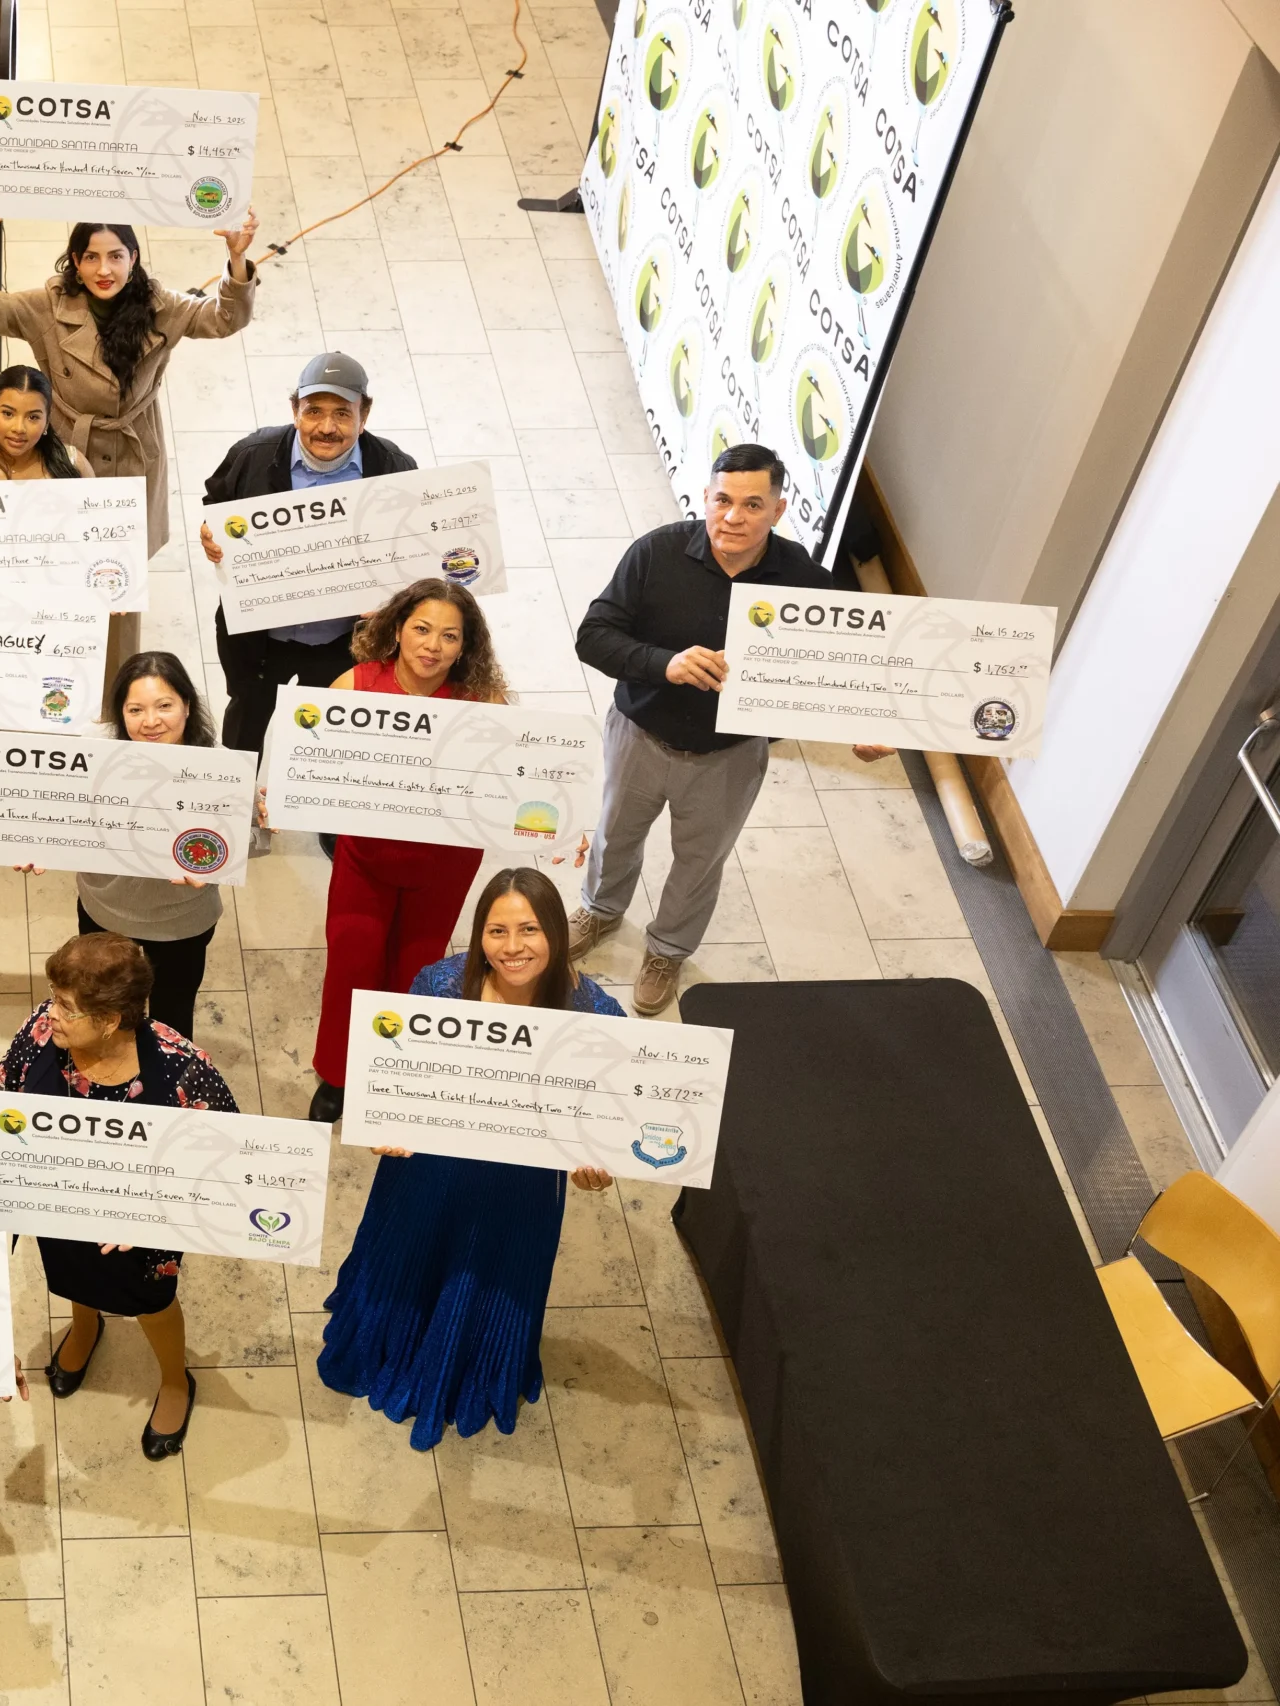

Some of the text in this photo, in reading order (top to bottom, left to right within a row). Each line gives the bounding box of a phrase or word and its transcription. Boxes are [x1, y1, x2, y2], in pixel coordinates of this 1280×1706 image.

[827, 20, 869, 107] COTSA
[16, 96, 111, 120] COTSA
[61, 139, 96, 151] SANTA
[98, 141, 138, 153] MARTA
[747, 113, 782, 194] COTSA
[875, 108, 916, 203] COTSA
[661, 187, 693, 264] COTSA
[781, 197, 810, 284] COTSA
[694, 268, 723, 350] COTSA
[809, 289, 869, 382] COTSA
[720, 355, 760, 442] COTSA
[251, 498, 346, 530] COTSA
[233, 545, 301, 564] COMUNIDAD
[303, 539, 333, 553] JUAN
[780, 603, 886, 631] COTSA
[747, 645, 913, 668] COMUNIDAD SANTA CLARA
[325, 705, 432, 734] COTSA
[738, 696, 898, 719] FONDO DE BECAS Y PROYECTOS
[521, 731, 586, 749] Nov 15 2025
[293, 745, 432, 767] COMUNIDAD CENTENO
[180, 767, 241, 783] Nov 15 2025
[32, 789, 75, 801] TIERRA
[78, 793, 129, 806] BLANCA
[409, 1013, 532, 1048] COTSA
[373, 1056, 596, 1091] COMUNIDAD TROMPINA ARRIBA
[31, 1111, 148, 1142] COTSA
[365, 1109, 547, 1139] FONDO DE BECAS Y PROYECTOS
[596, 1114, 624, 1122] DOLLARS
[0, 1150, 175, 1177] COMUNIDAD BAJO LEMPA
